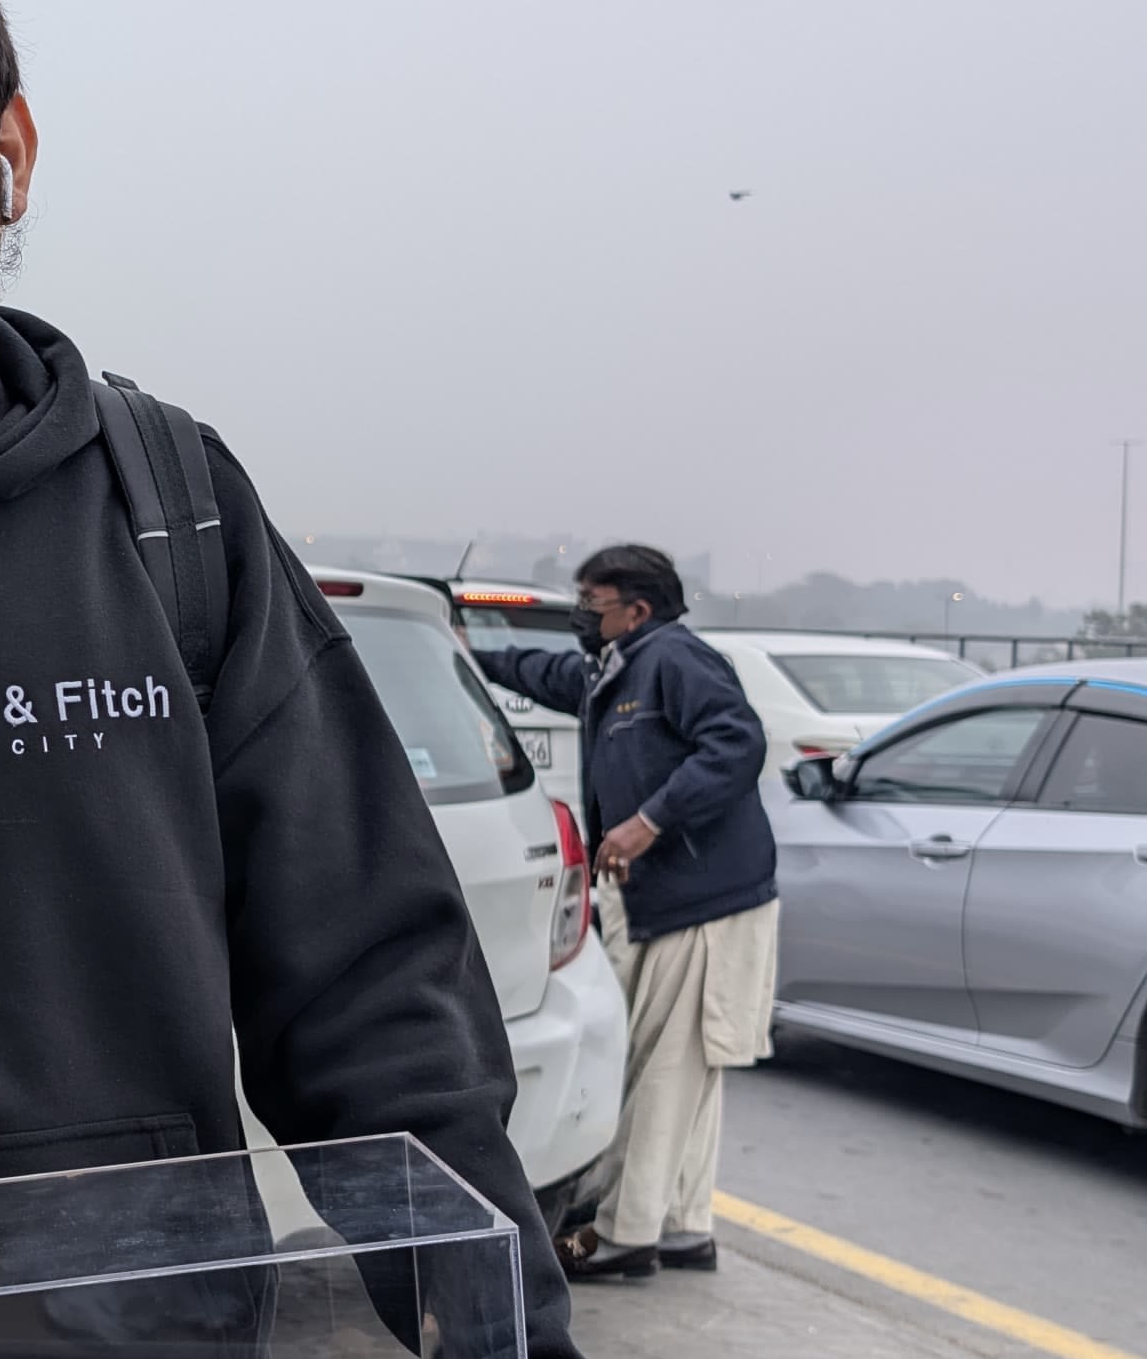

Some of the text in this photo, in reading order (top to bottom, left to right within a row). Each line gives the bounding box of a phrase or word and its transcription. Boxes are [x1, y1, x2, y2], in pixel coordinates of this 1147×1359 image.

[3, 684, 39, 728] &
[54, 675, 171, 721] Fitch
[11, 732, 105, 755] CITY
